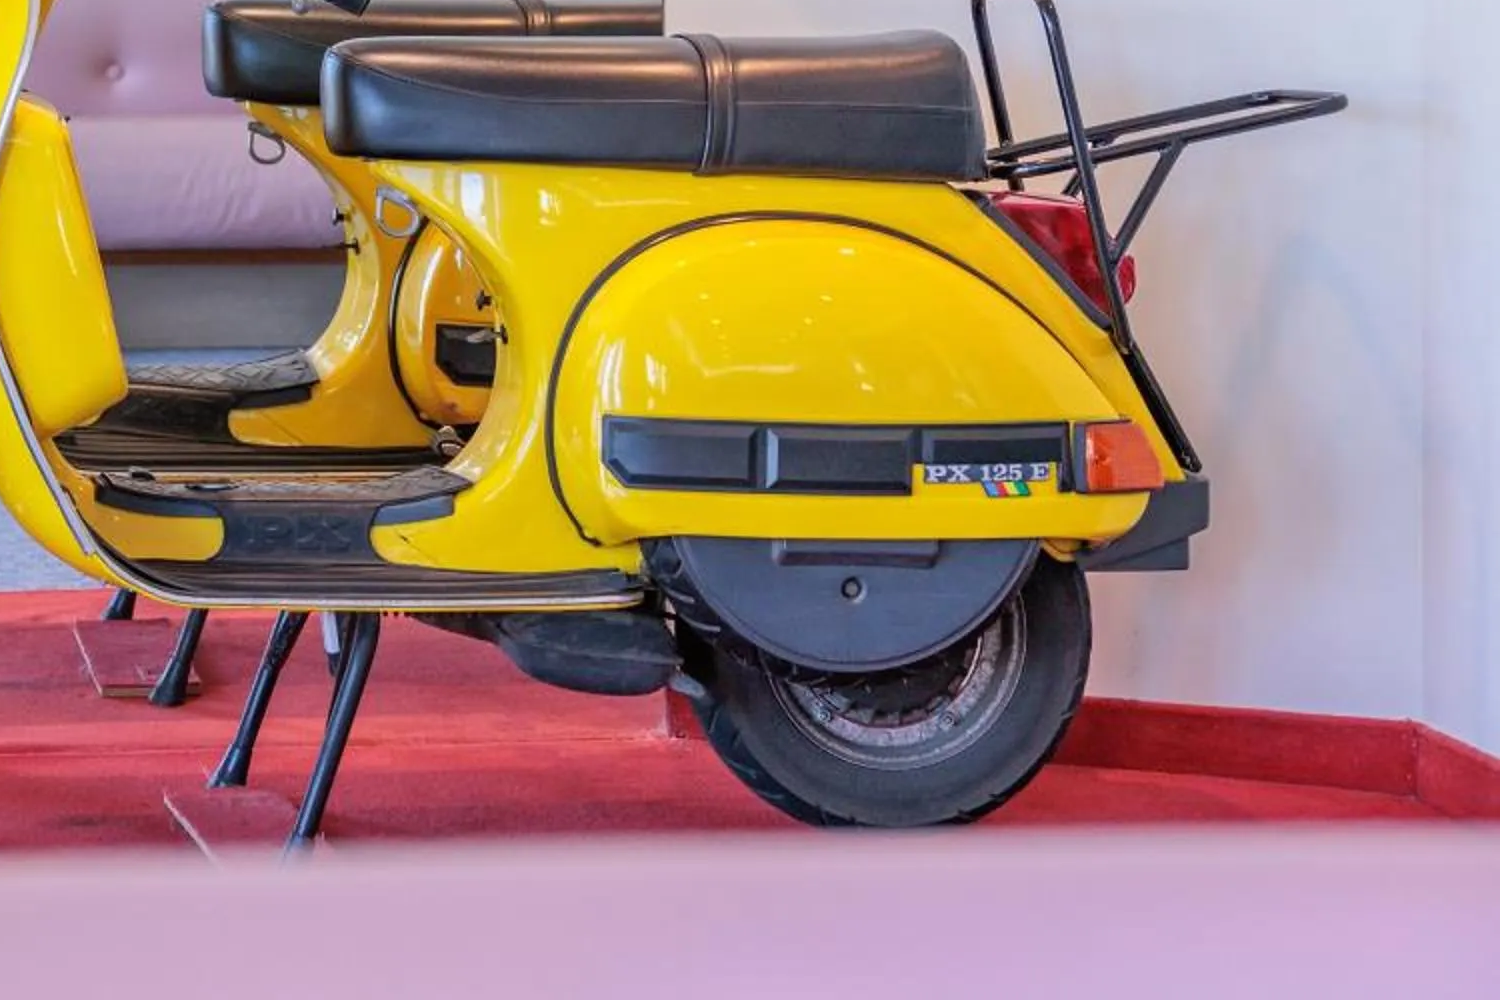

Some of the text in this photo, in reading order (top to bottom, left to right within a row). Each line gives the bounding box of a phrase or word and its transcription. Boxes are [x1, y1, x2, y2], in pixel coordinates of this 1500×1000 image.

[926, 463, 1049, 482] PX 125 E
